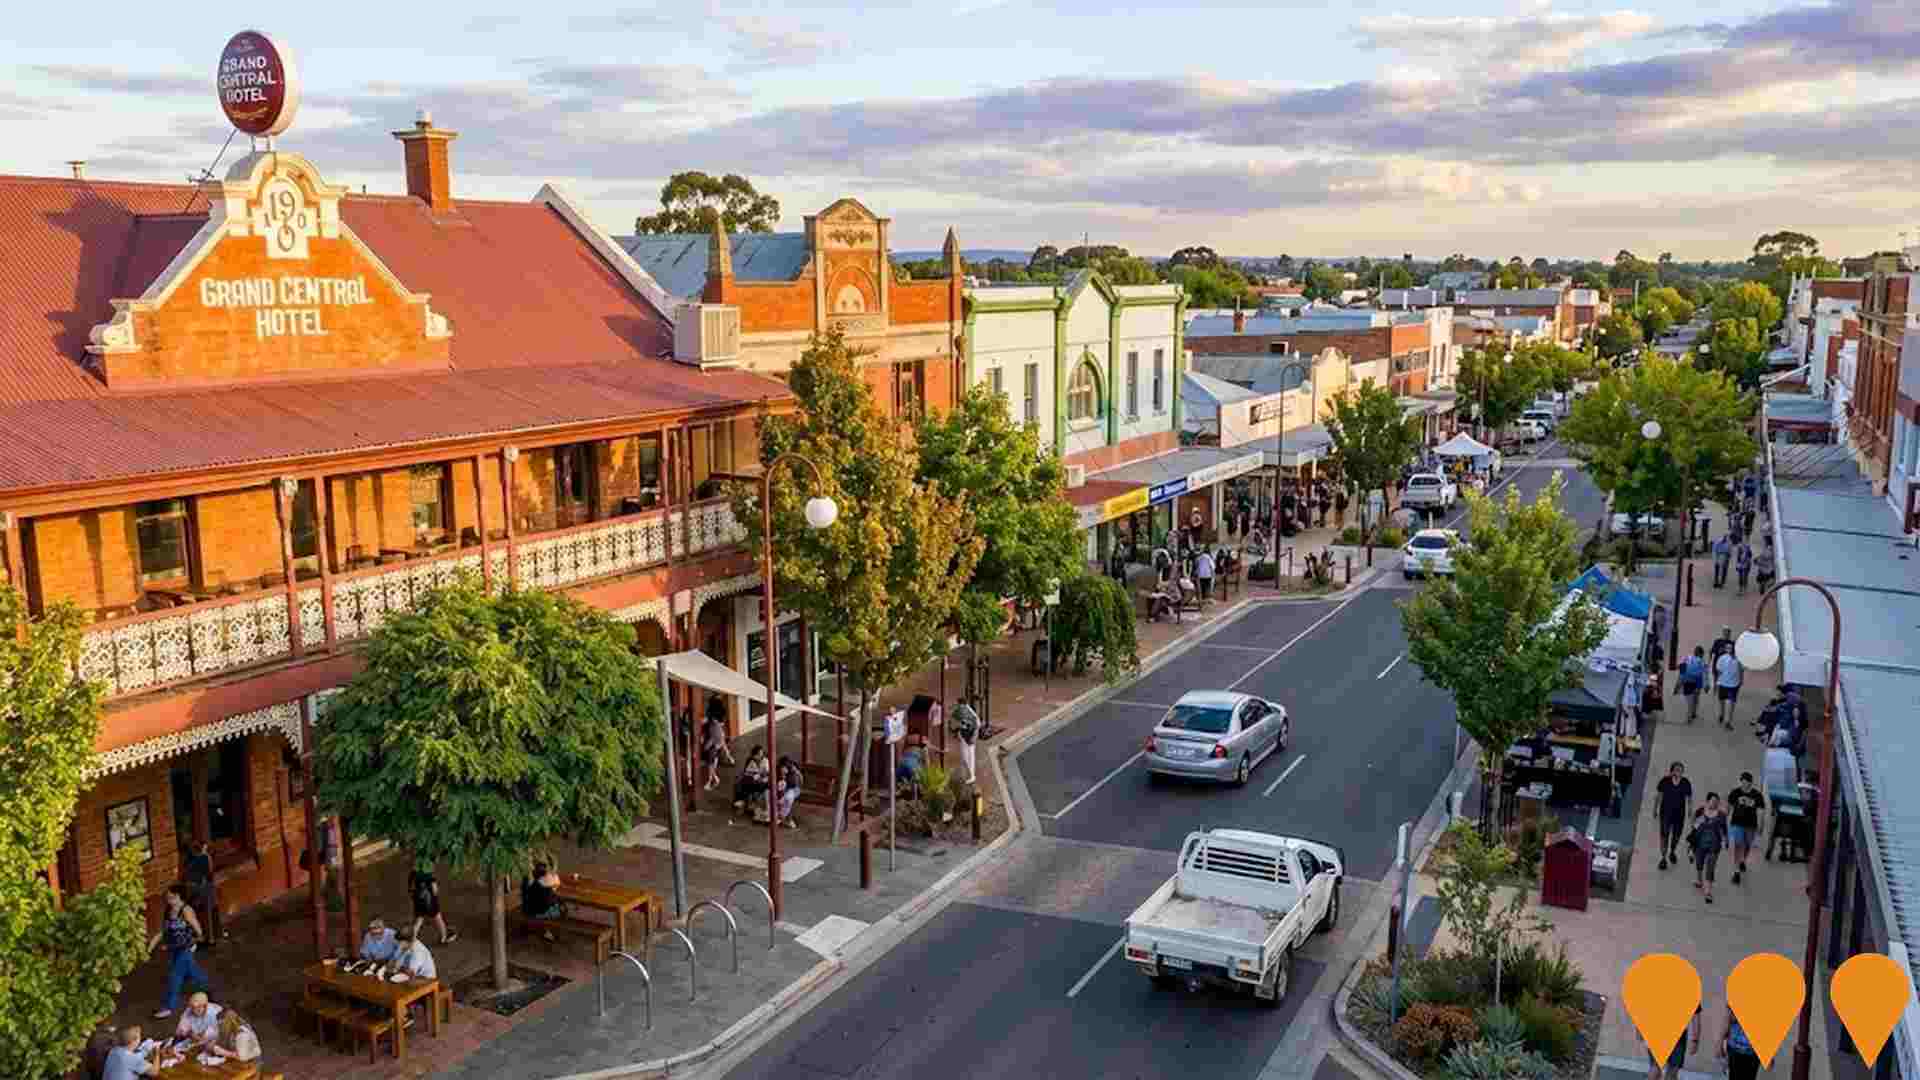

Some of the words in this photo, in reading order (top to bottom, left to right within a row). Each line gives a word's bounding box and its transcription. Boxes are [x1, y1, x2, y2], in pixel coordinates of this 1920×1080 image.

[201, 277, 274, 307] GRAND
[280, 275, 375, 307] CENTRAL
[256, 308, 329, 338] HOTEL
